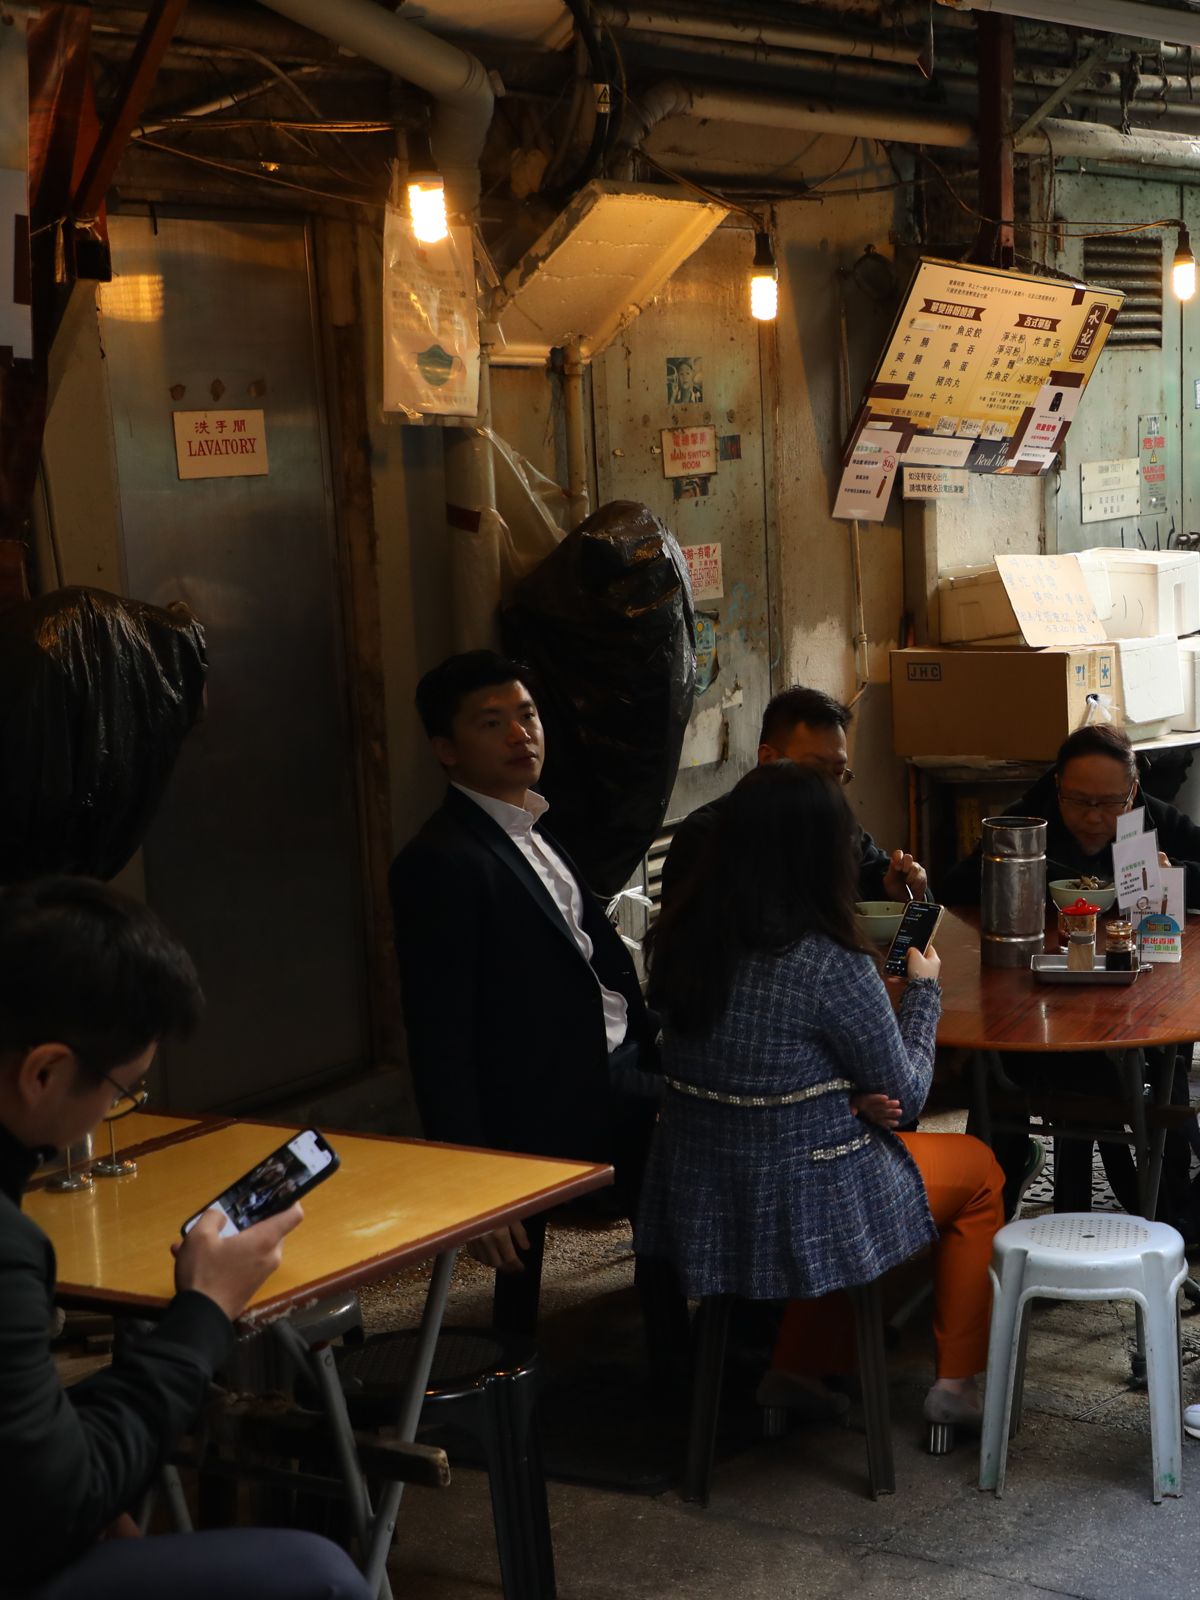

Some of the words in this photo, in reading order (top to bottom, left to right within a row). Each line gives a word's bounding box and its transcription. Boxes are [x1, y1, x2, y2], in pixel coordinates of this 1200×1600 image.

[956, 325, 982, 338] 魚皮餃
[187, 438, 257, 457] LAVATORY
[670, 450, 687, 461] MAIN
[688, 450, 711, 460] SWITCH
[682, 461, 701, 471] ROOM
[910, 666, 939, 678] JHC
